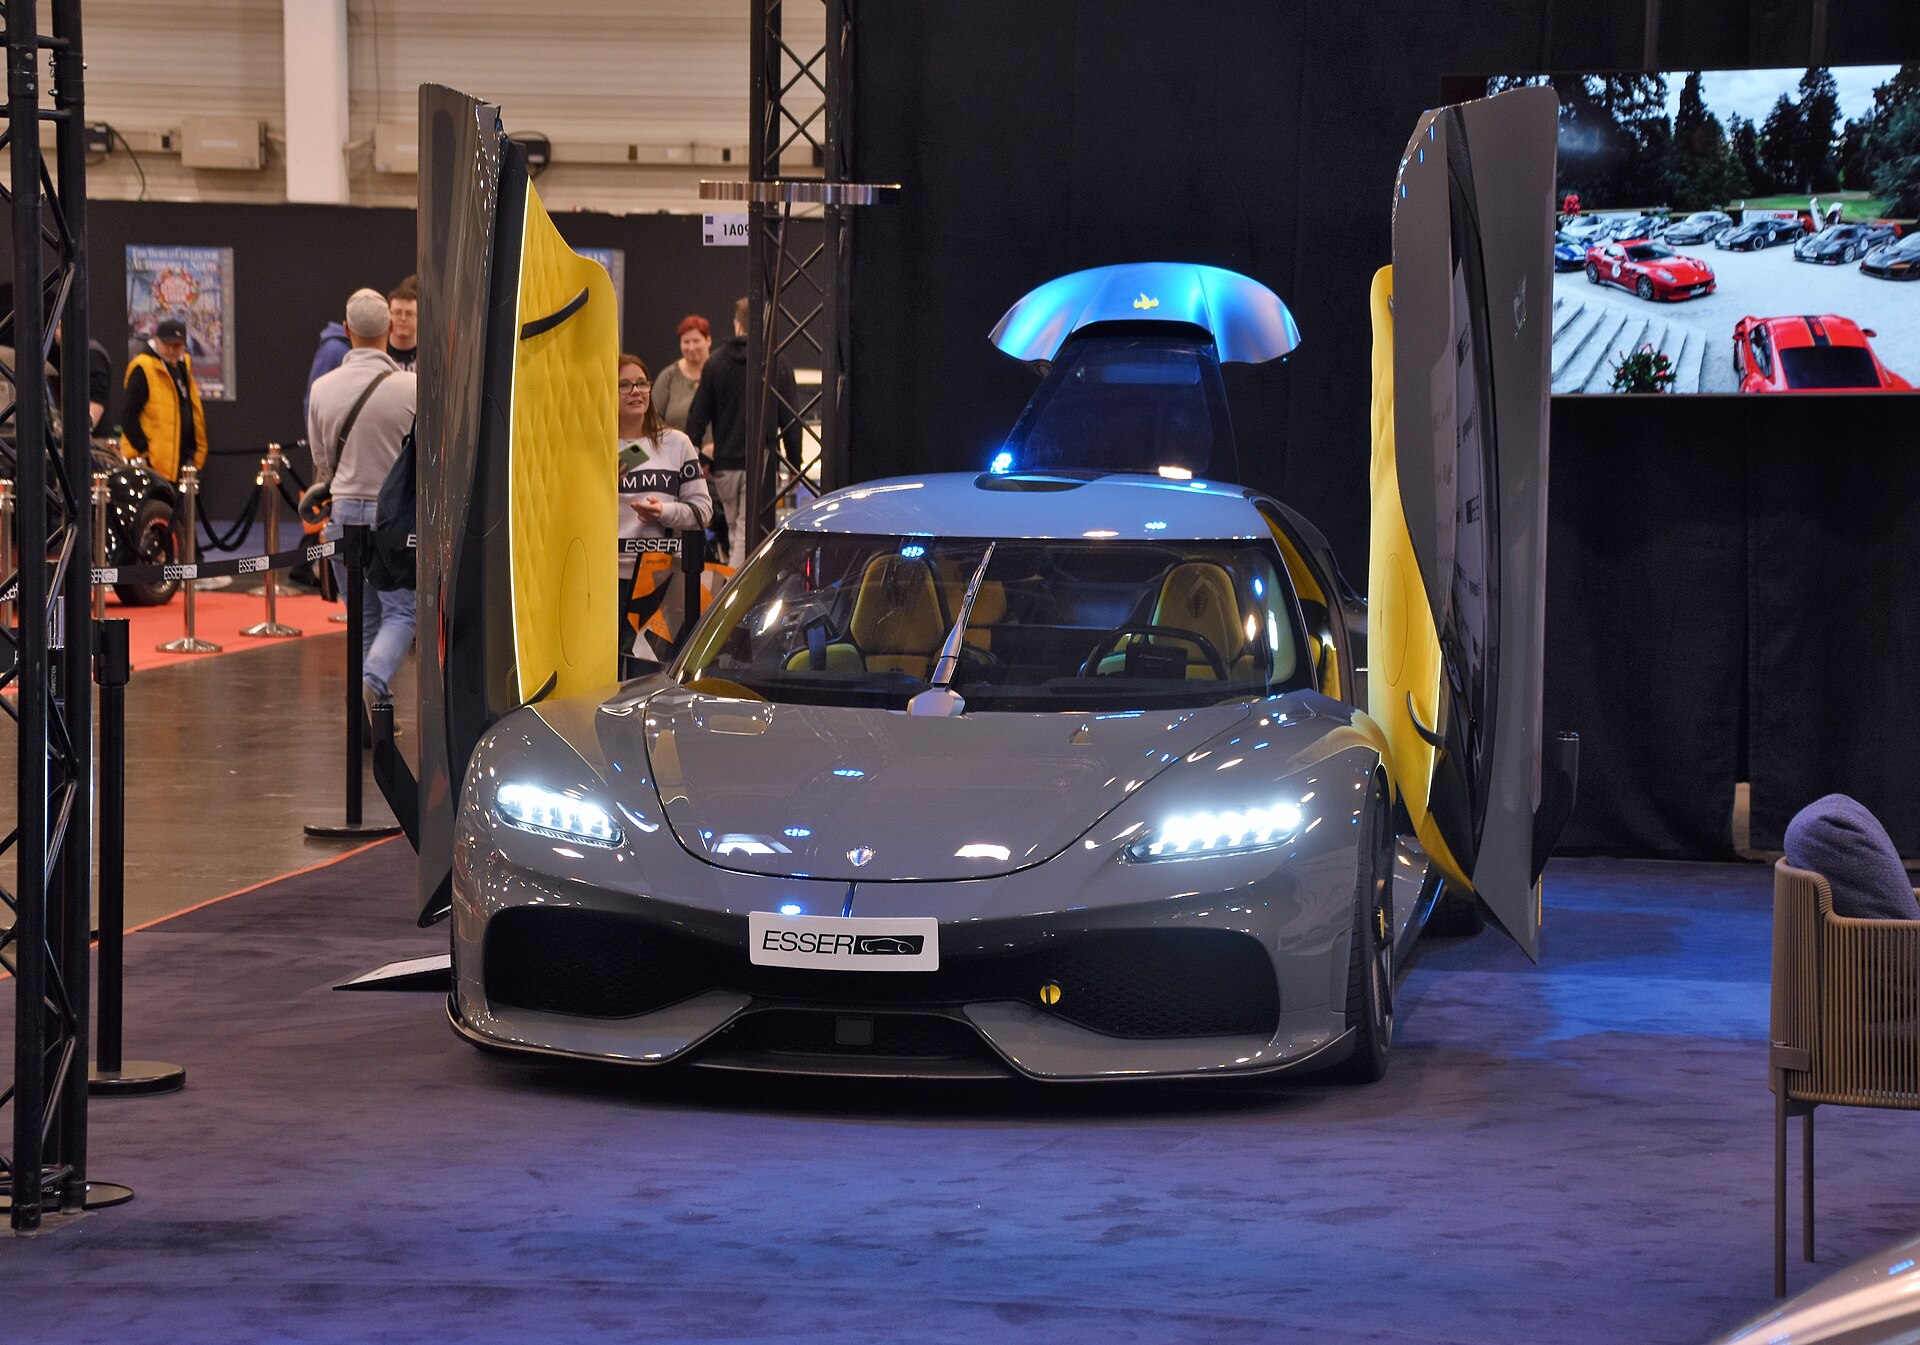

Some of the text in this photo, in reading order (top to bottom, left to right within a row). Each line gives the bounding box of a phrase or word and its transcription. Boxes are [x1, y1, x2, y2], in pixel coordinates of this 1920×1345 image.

[624, 539, 678, 553] ESSER
[163, 564, 183, 580] ESSER
[239, 557, 257, 574] ESSER
[306, 544, 324, 561] ESSER
[762, 929, 854, 955] ESSER
